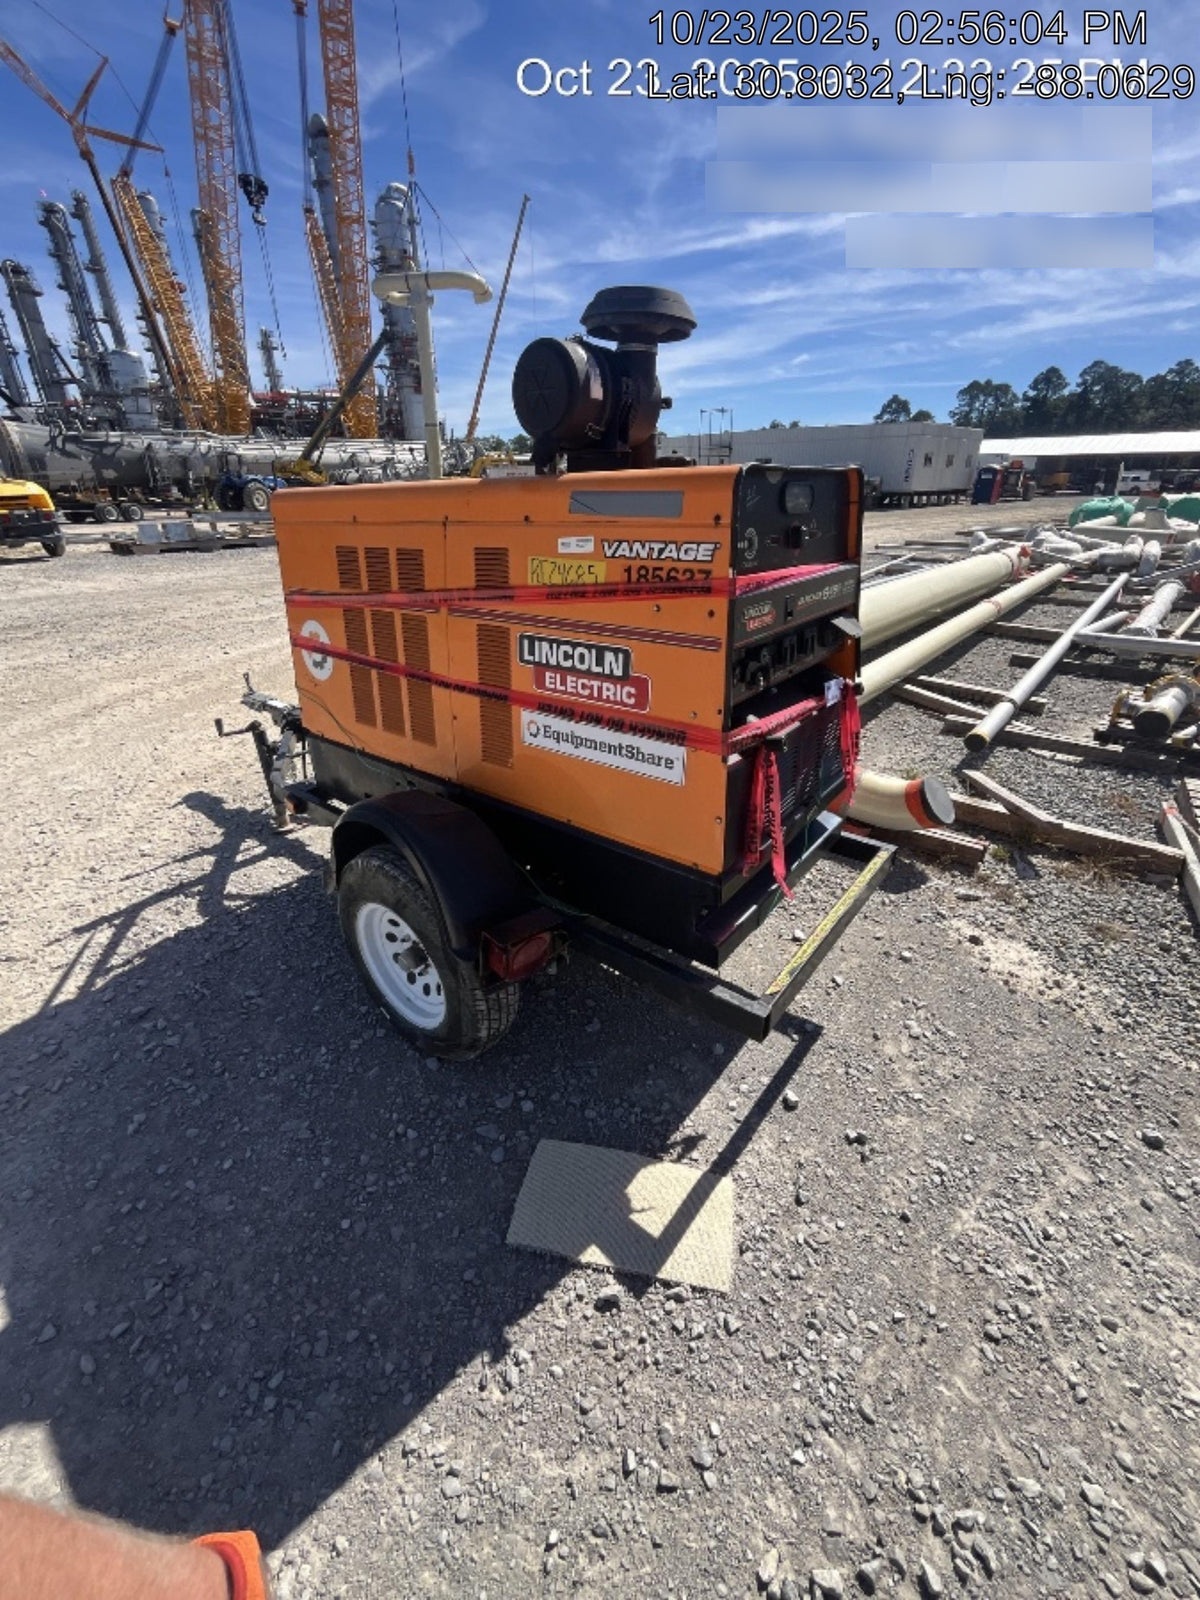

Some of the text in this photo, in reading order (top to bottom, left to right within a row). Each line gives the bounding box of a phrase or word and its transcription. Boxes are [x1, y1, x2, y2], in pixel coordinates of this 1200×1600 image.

[602, 540, 715, 561] VANTAGE
[522, 638, 624, 677] LINCOLN
[545, 671, 636, 705] ELECTRIC
[543, 723, 676, 771] EquipmentShare
